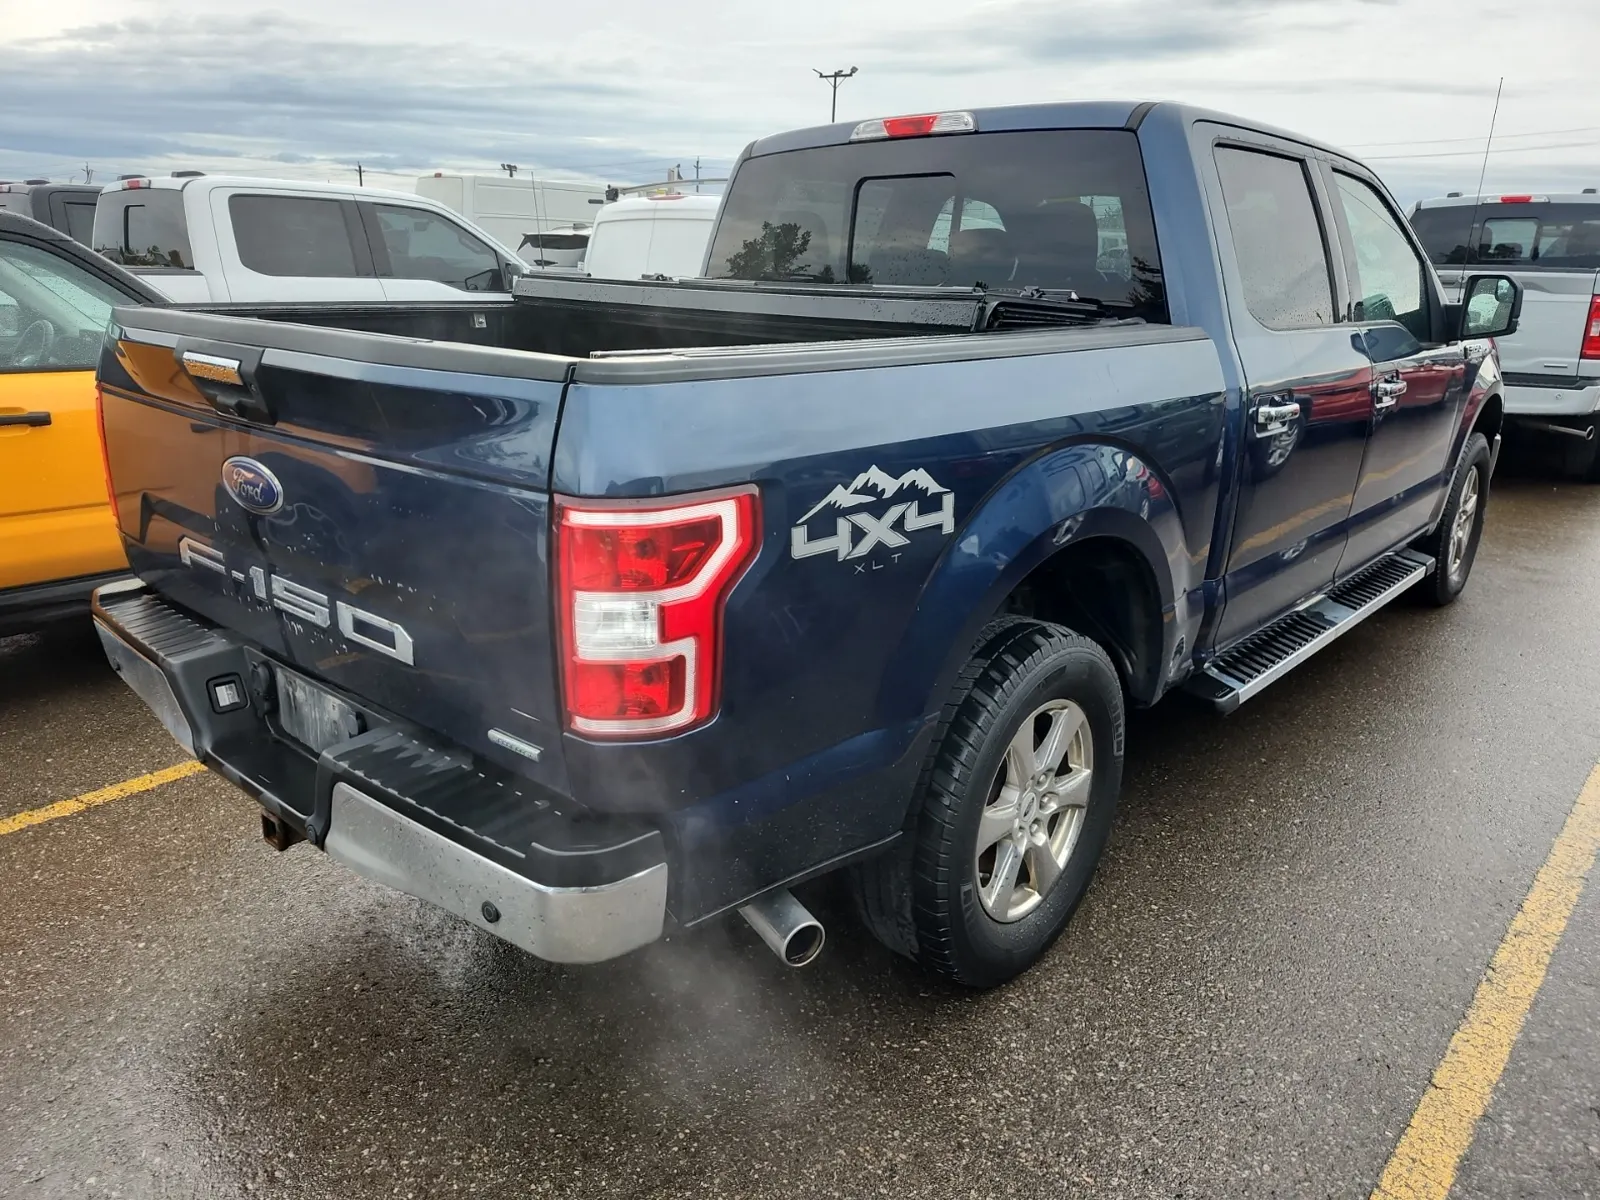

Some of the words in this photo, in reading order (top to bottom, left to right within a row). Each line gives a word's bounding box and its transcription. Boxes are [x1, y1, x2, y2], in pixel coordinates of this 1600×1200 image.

[231, 467, 266, 502] Ford
[853, 552, 903, 576] XLT
[178, 535, 415, 667] F-150
